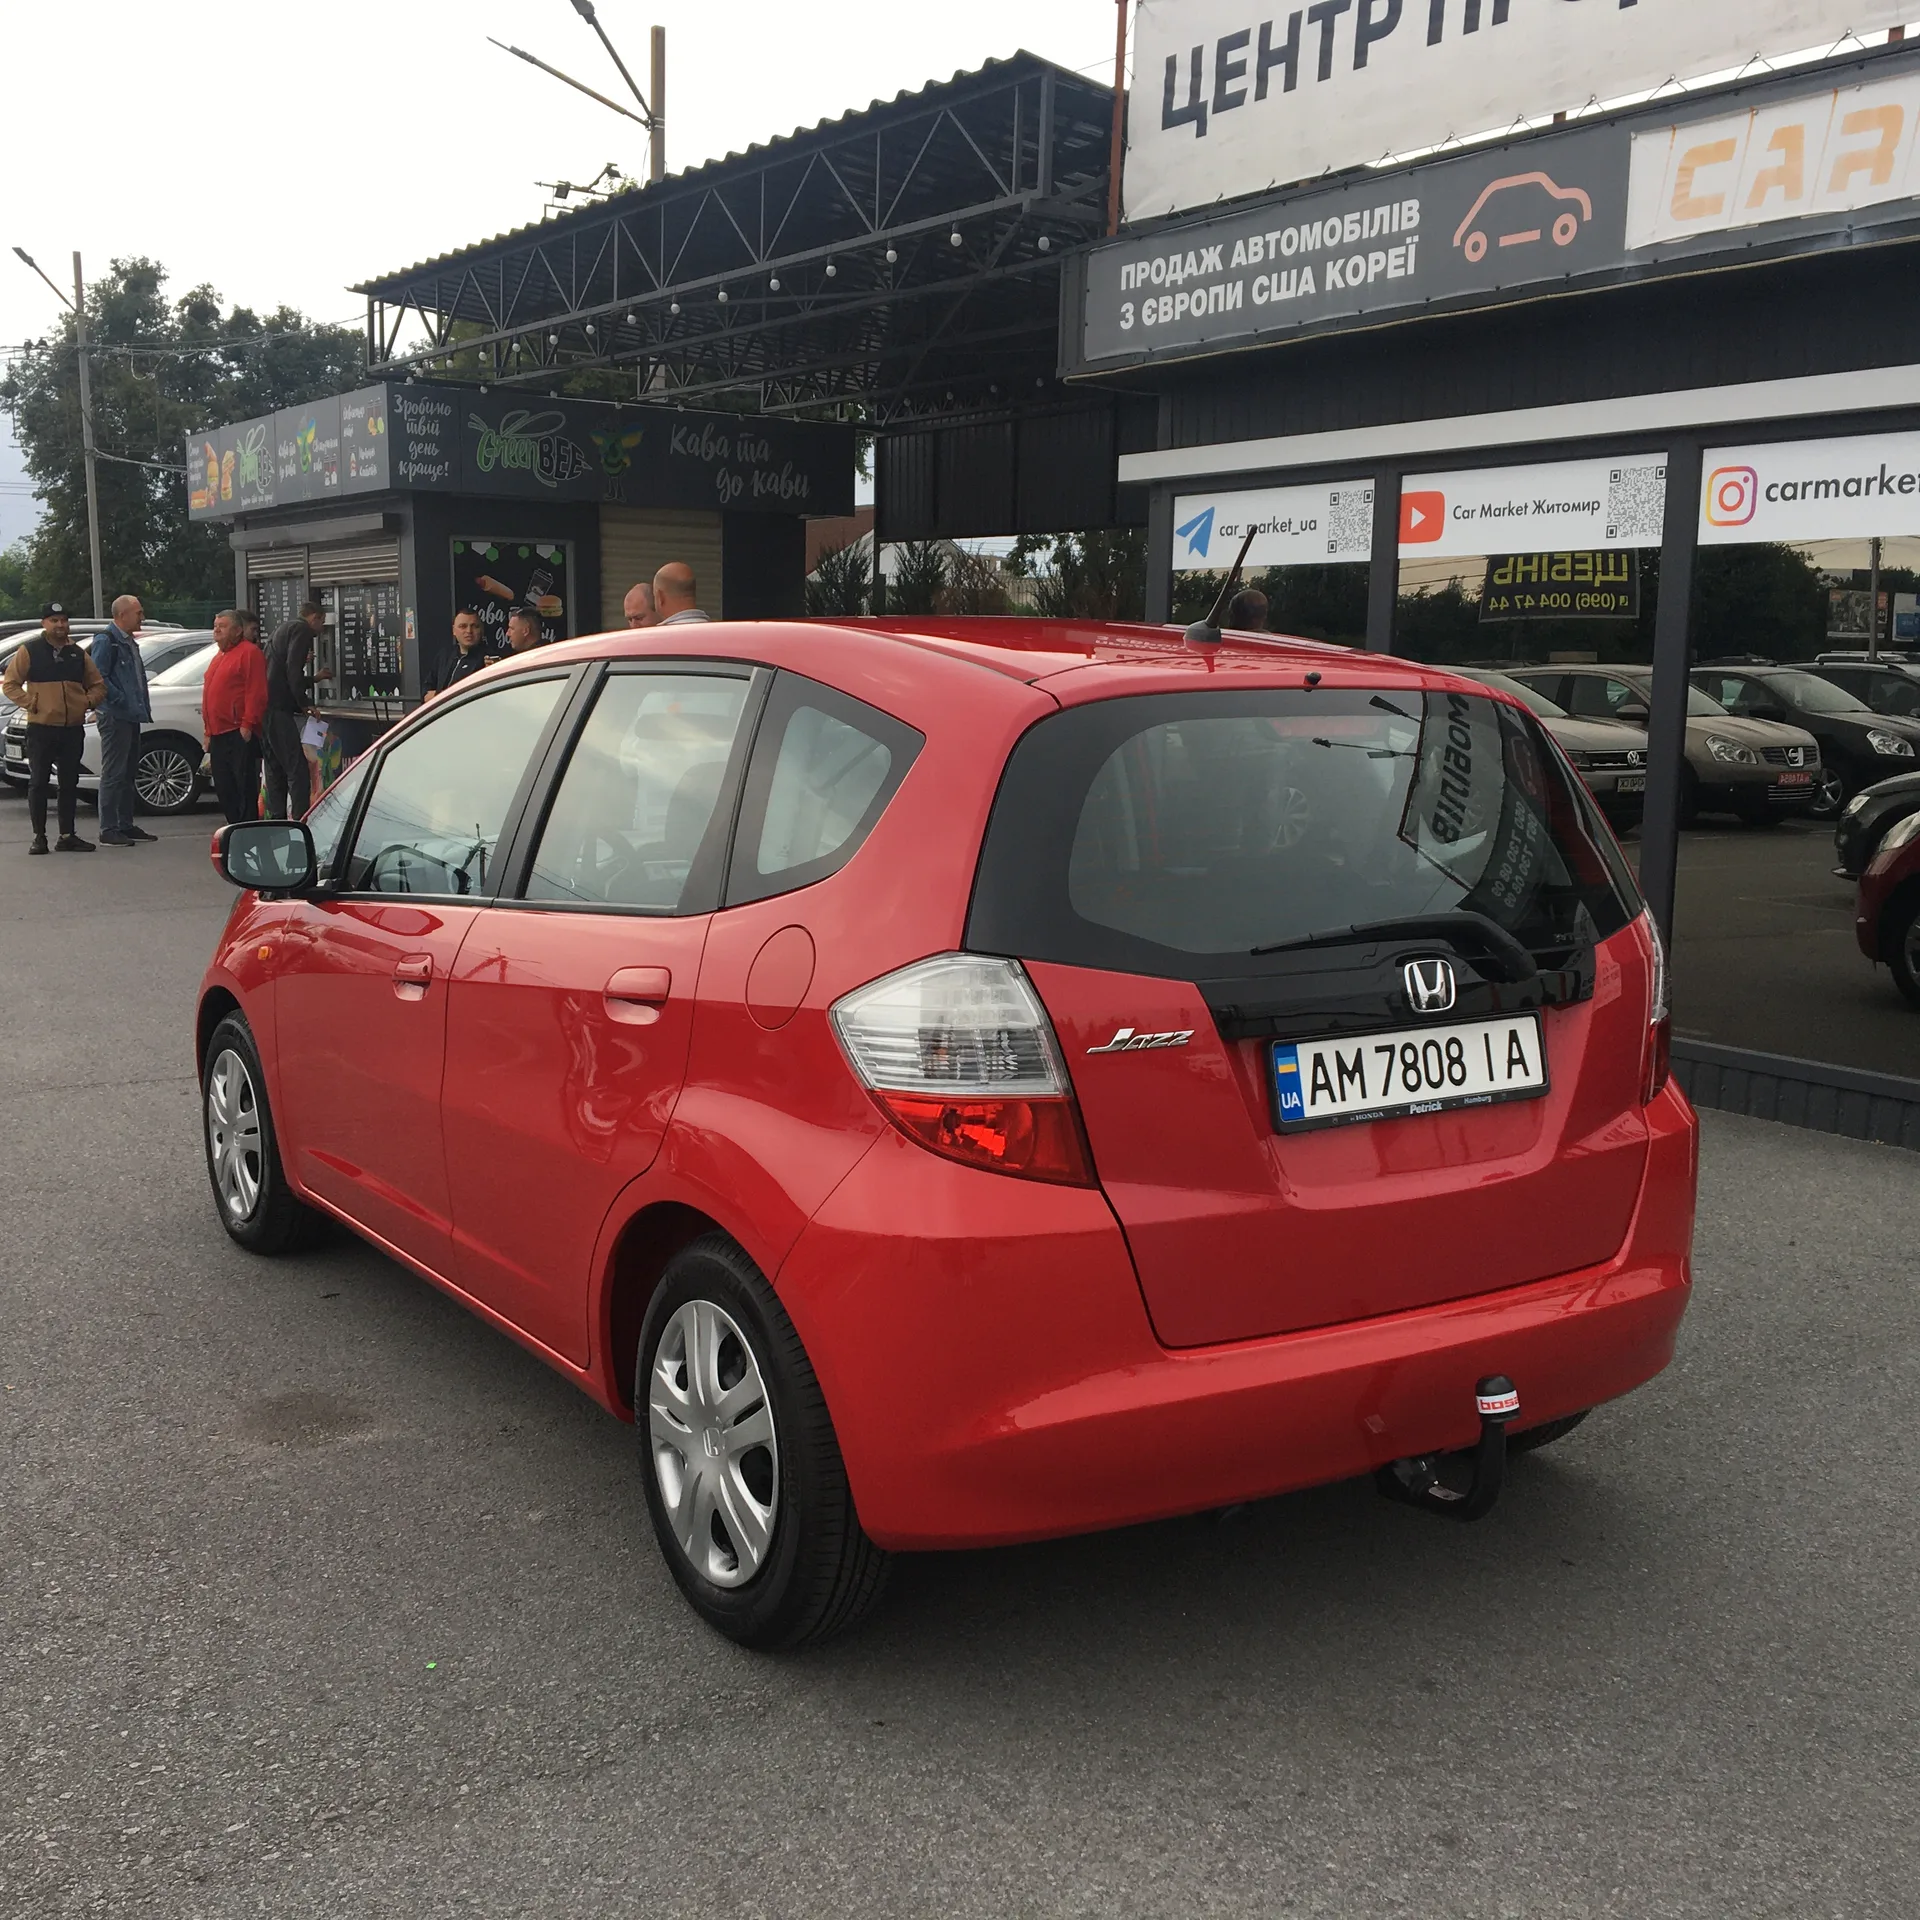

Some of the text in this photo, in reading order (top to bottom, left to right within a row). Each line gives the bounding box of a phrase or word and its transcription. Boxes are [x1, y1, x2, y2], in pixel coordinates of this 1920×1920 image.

[1160, 0, 1401, 138] ЦЕНТР
[1120, 197, 1421, 291] ПРОДАЖ АВТОМОБІЛІВ
[1120, 235, 1417, 330] З ЄВРОПИ США КОРЕЇ
[394, 394, 452, 419] Зробимо
[407, 416, 440, 437] твій
[670, 423, 772, 463] Кава та
[408, 443, 440, 459] день
[398, 461, 449, 482] краще!
[716, 462, 810, 504] до кави
[1765, 463, 1920, 502] carmarke
[1452, 497, 1601, 522] Car Market Житомир
[1281, 1029, 1530, 1110] UA AM 7808 IA
[1355, 1094, 1492, 1121] HONDA Petrick Hamburg
